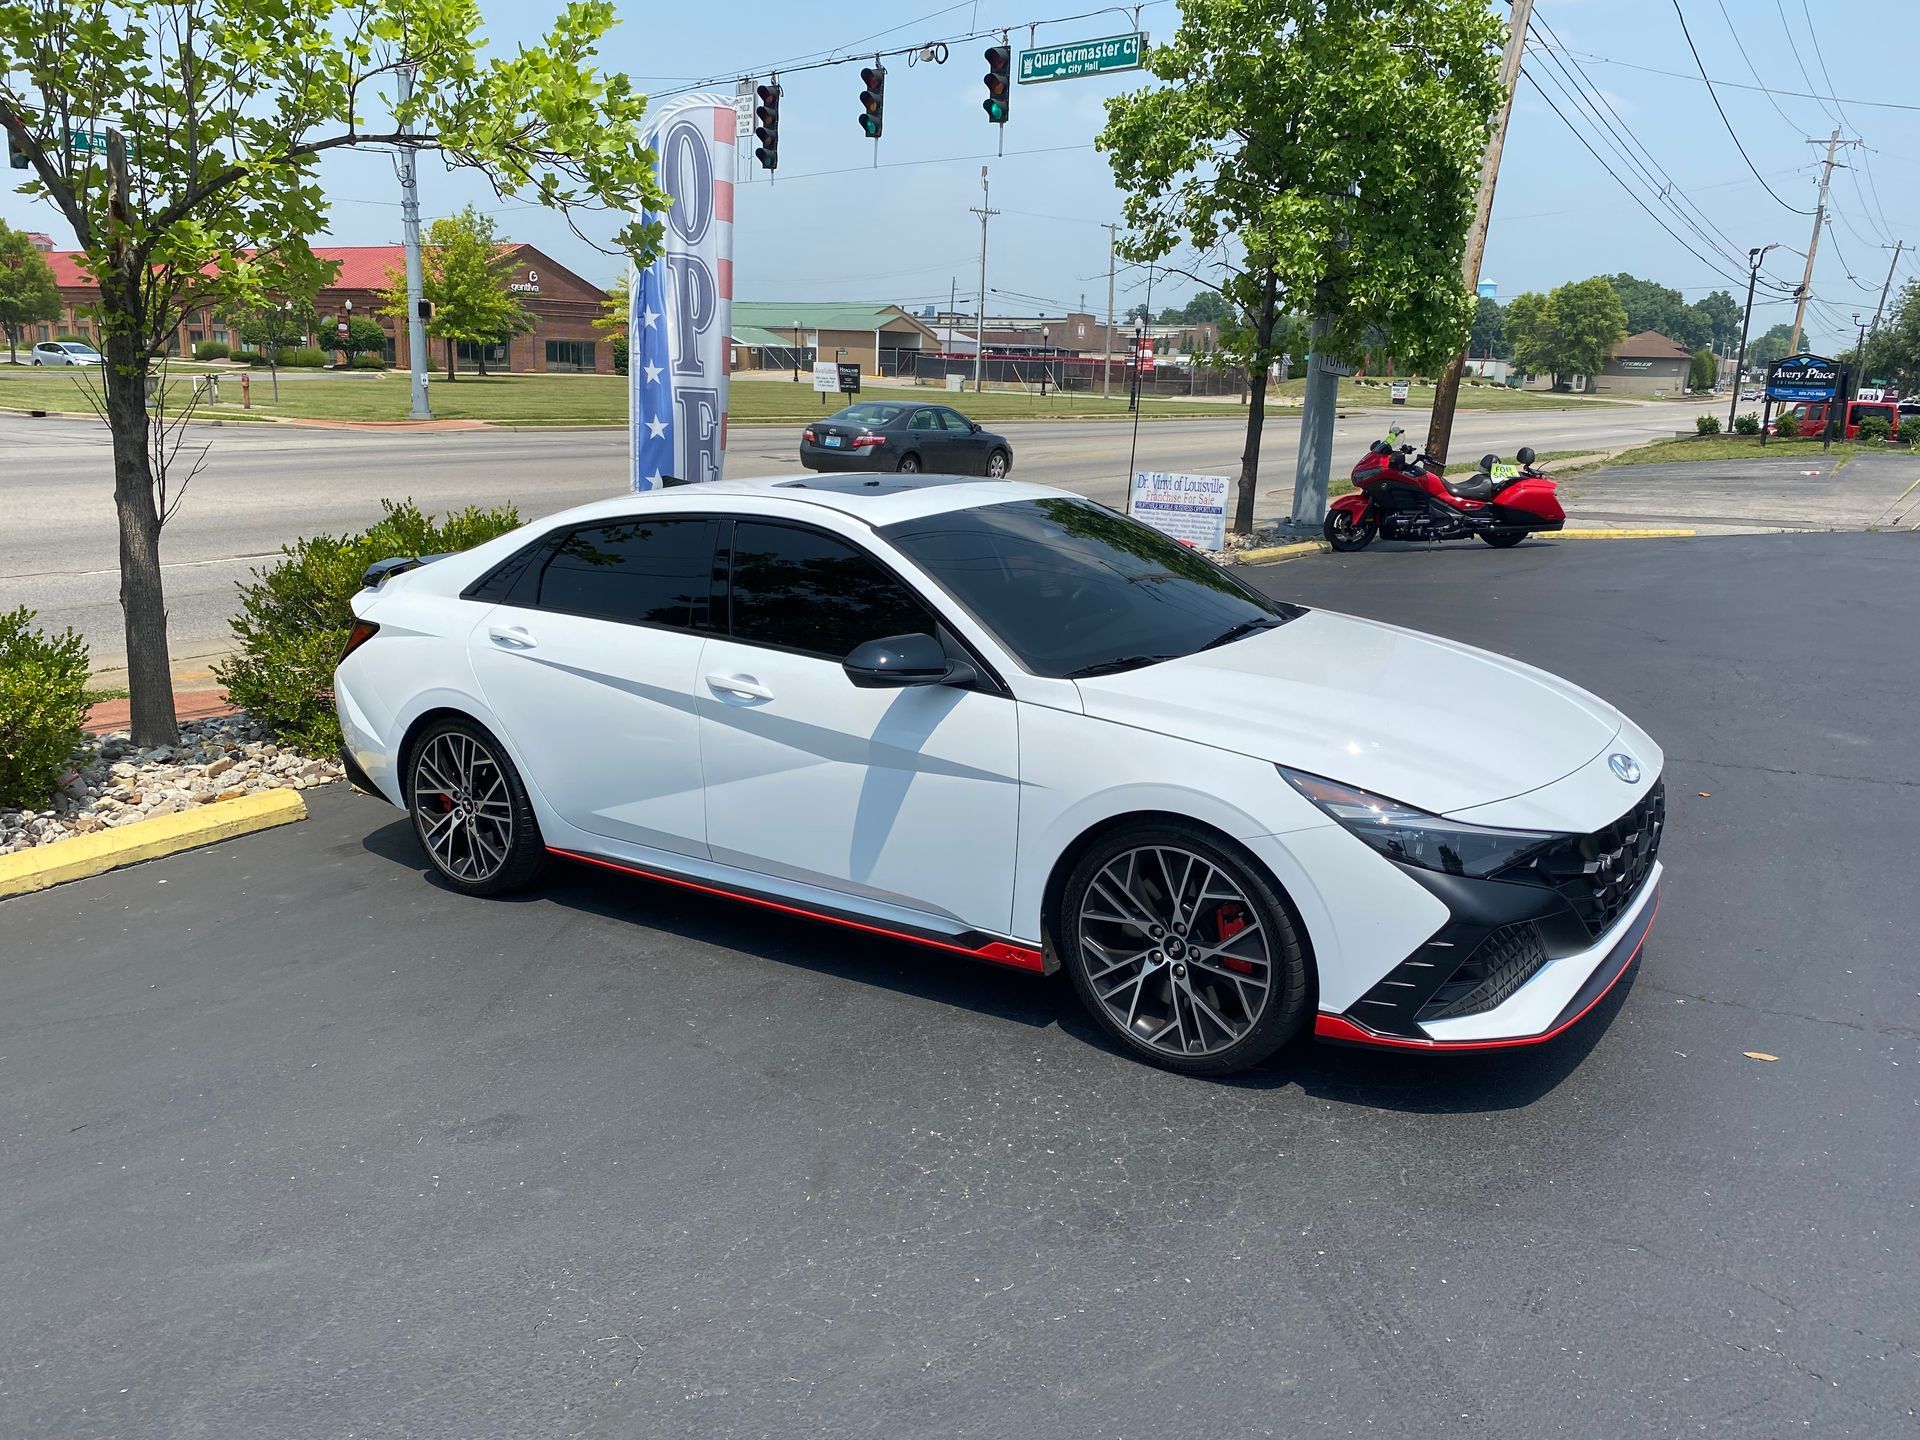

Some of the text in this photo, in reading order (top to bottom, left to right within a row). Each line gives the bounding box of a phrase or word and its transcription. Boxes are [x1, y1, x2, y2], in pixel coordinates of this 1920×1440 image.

[1034, 38, 1137, 68] Quartermaster Ct
[1084, 61, 1098, 72] Hall
[510, 282, 539, 292] gentiva
[1772, 368, 1835, 380] Avery Place
[1137, 474, 1224, 494] Dr. Vinyl of Louisville
[1146, 490, 1214, 505] Franchise For Sale
